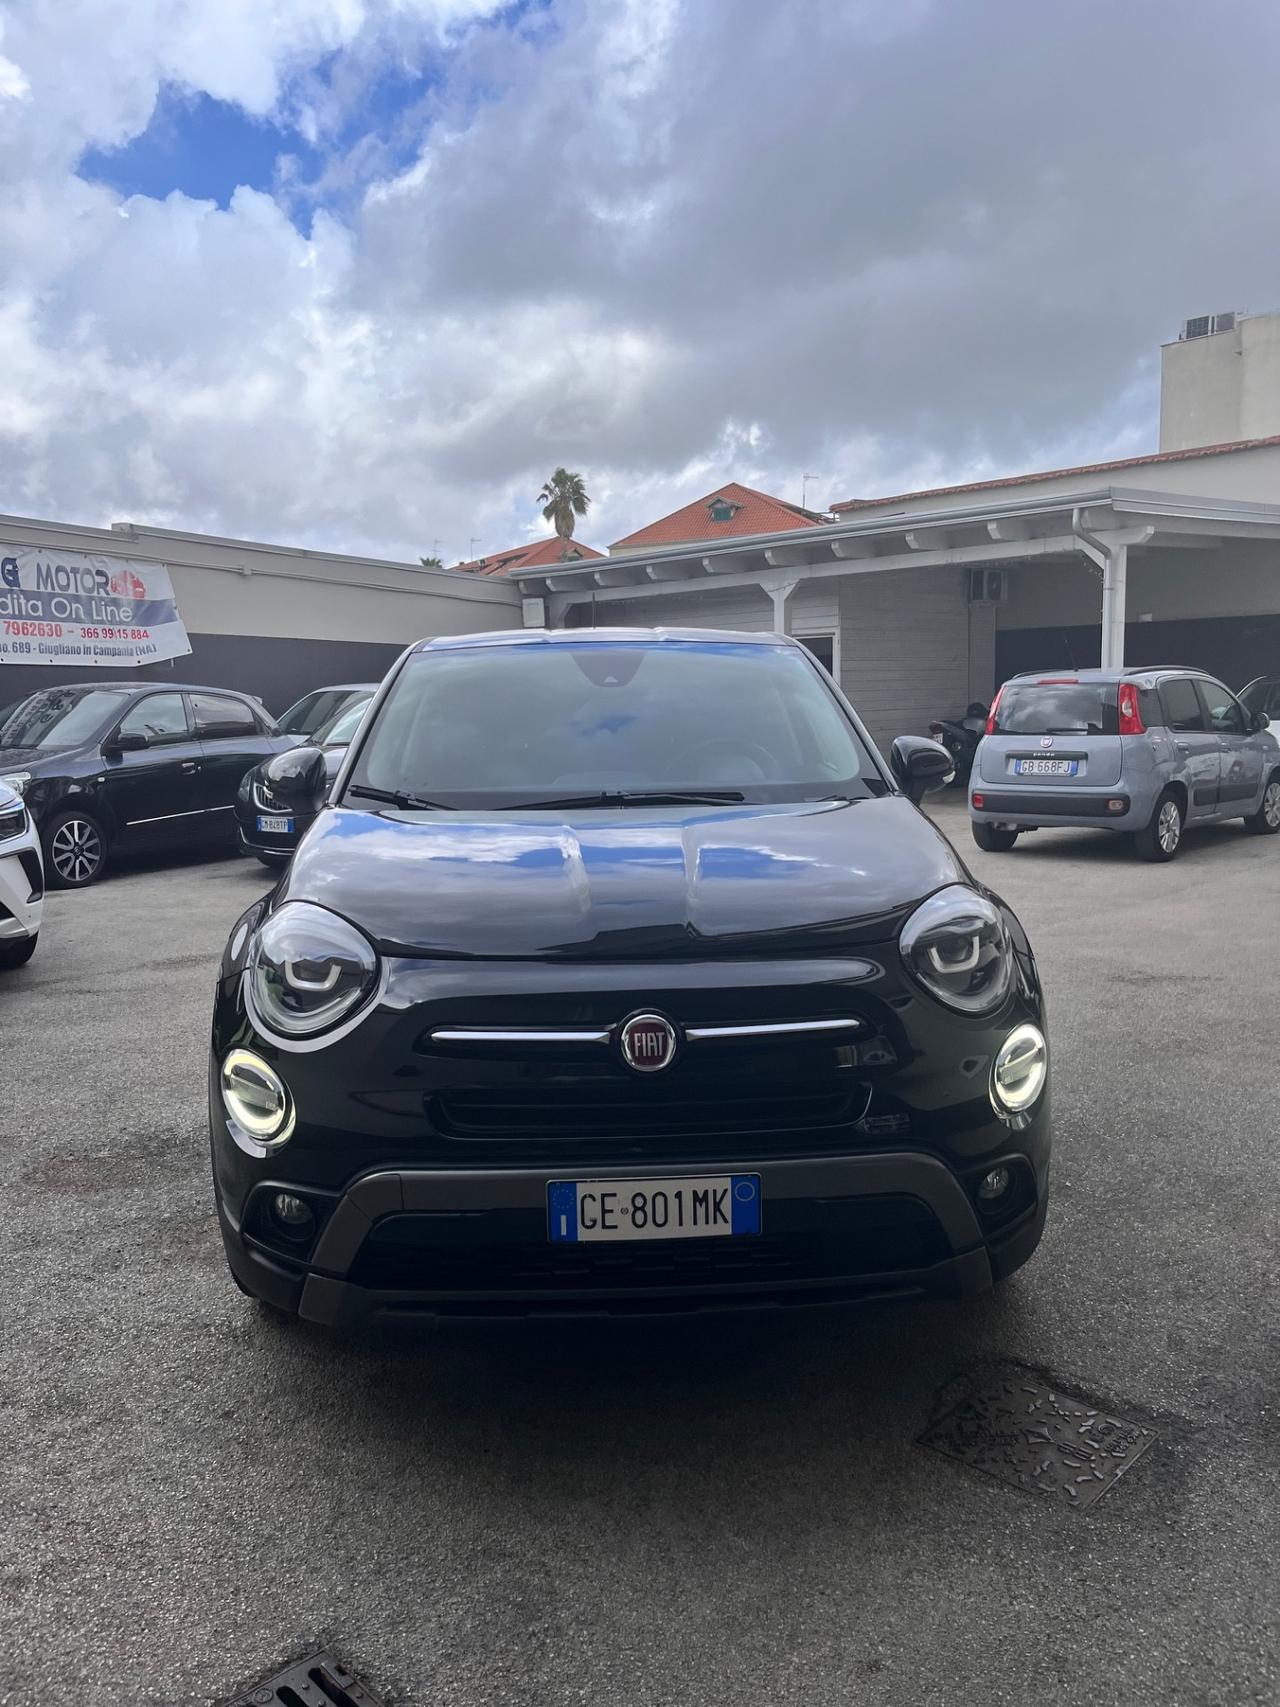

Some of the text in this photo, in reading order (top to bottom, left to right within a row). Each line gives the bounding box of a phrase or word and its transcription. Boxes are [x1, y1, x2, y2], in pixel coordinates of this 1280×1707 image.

[51, 597, 84, 619] On
[92, 600, 133, 622] Line
[3, 620, 62, 638] 7962630
[81, 627, 99, 639] 366
[12, 641, 31, 654] 689
[38, 642, 81, 656] Giugliano
[83, 644, 92, 656] in
[93, 645, 134, 657] Campania
[634, 1032, 665, 1057] FIAT
